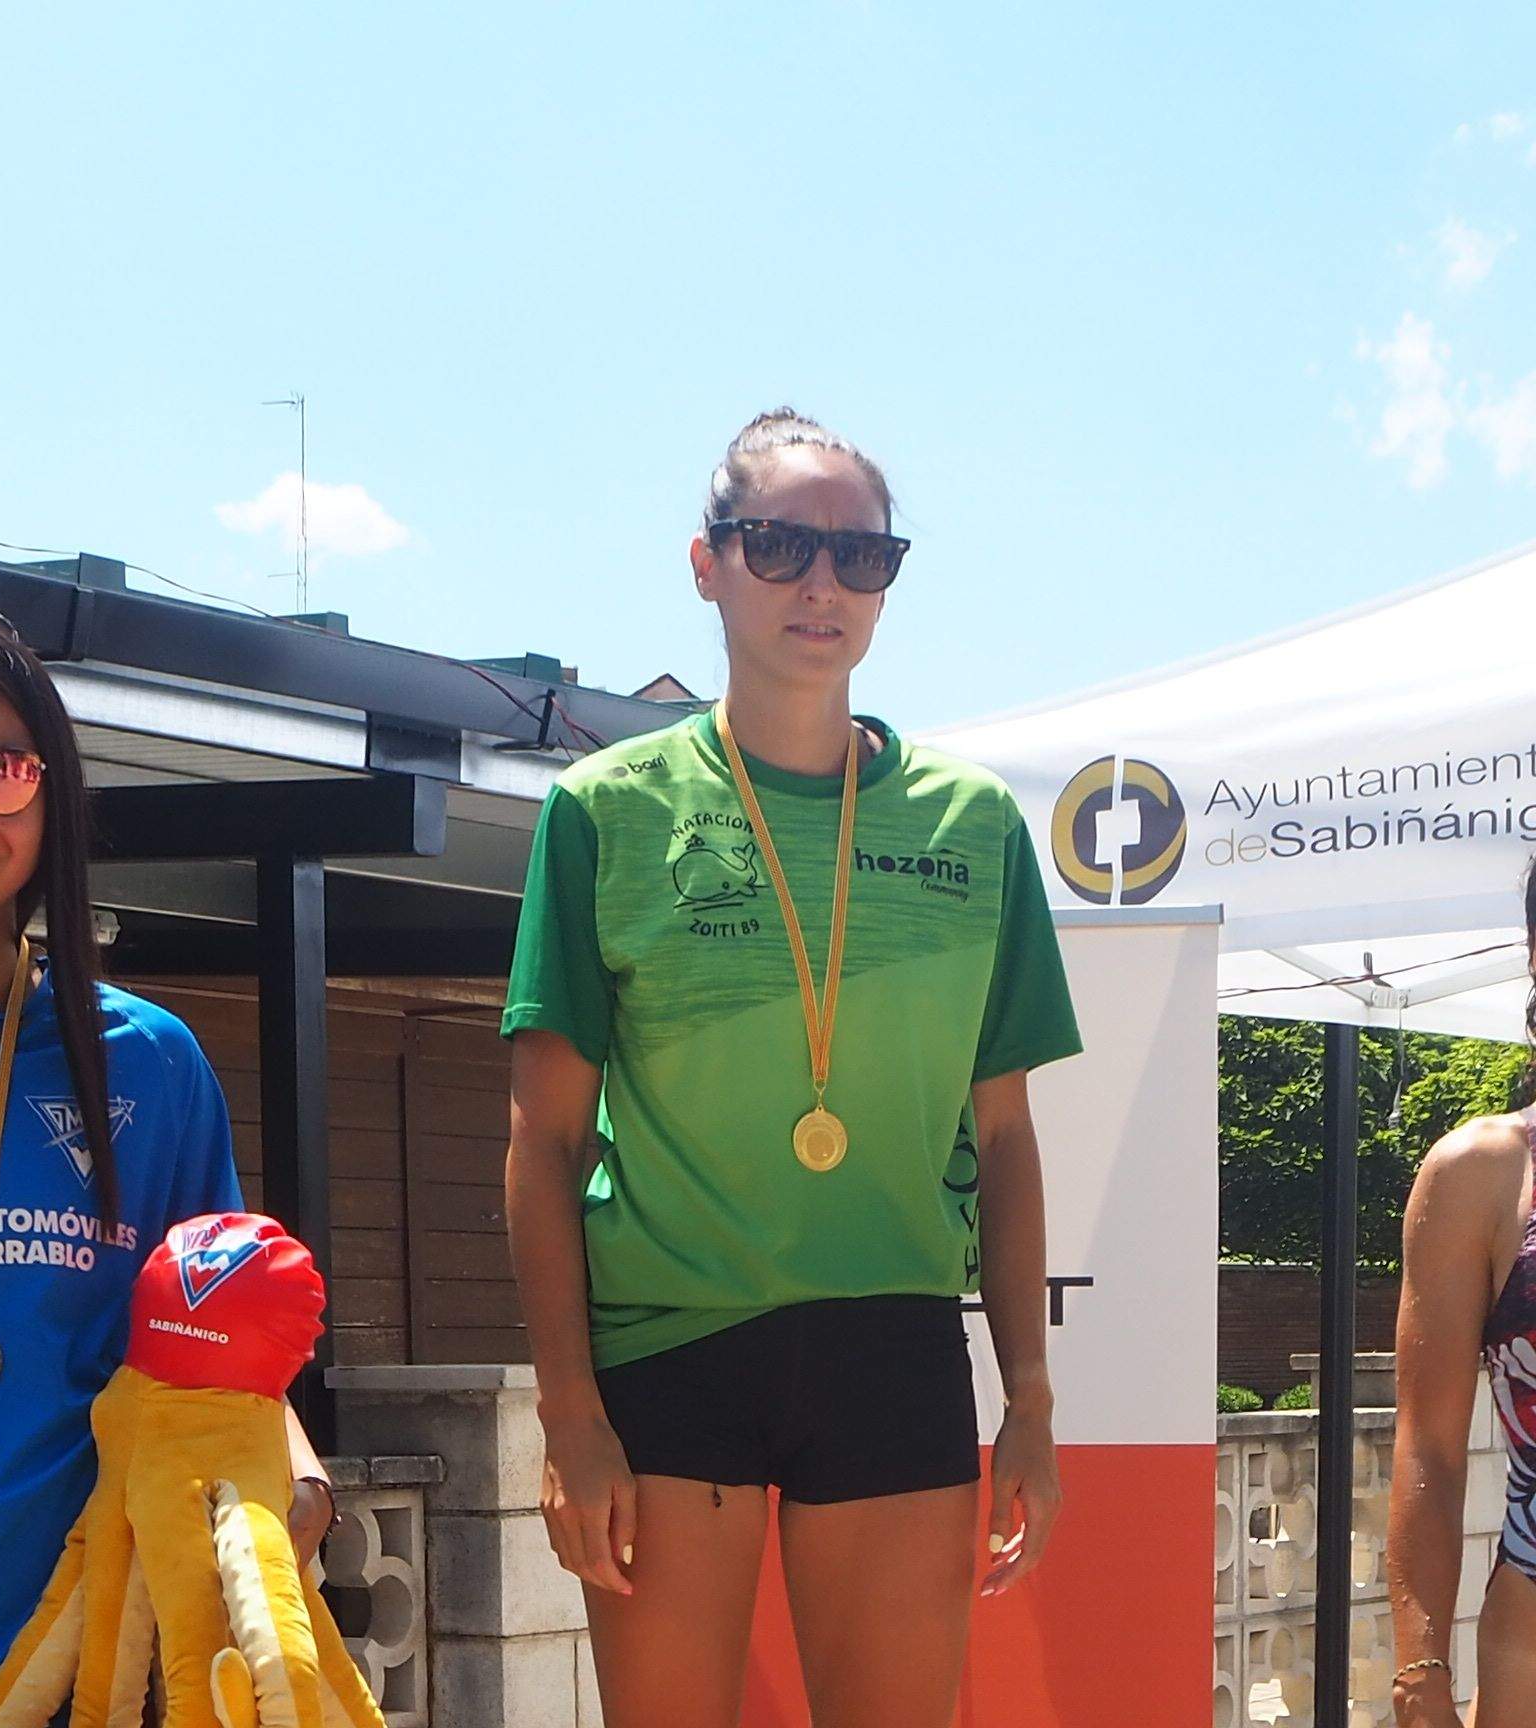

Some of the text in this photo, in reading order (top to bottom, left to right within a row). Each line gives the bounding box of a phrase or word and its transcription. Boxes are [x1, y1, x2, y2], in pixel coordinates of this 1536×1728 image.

[671, 812, 754, 839] NATACION
[854, 847, 970, 885] hozona
[742, 917, 760, 936] 89
